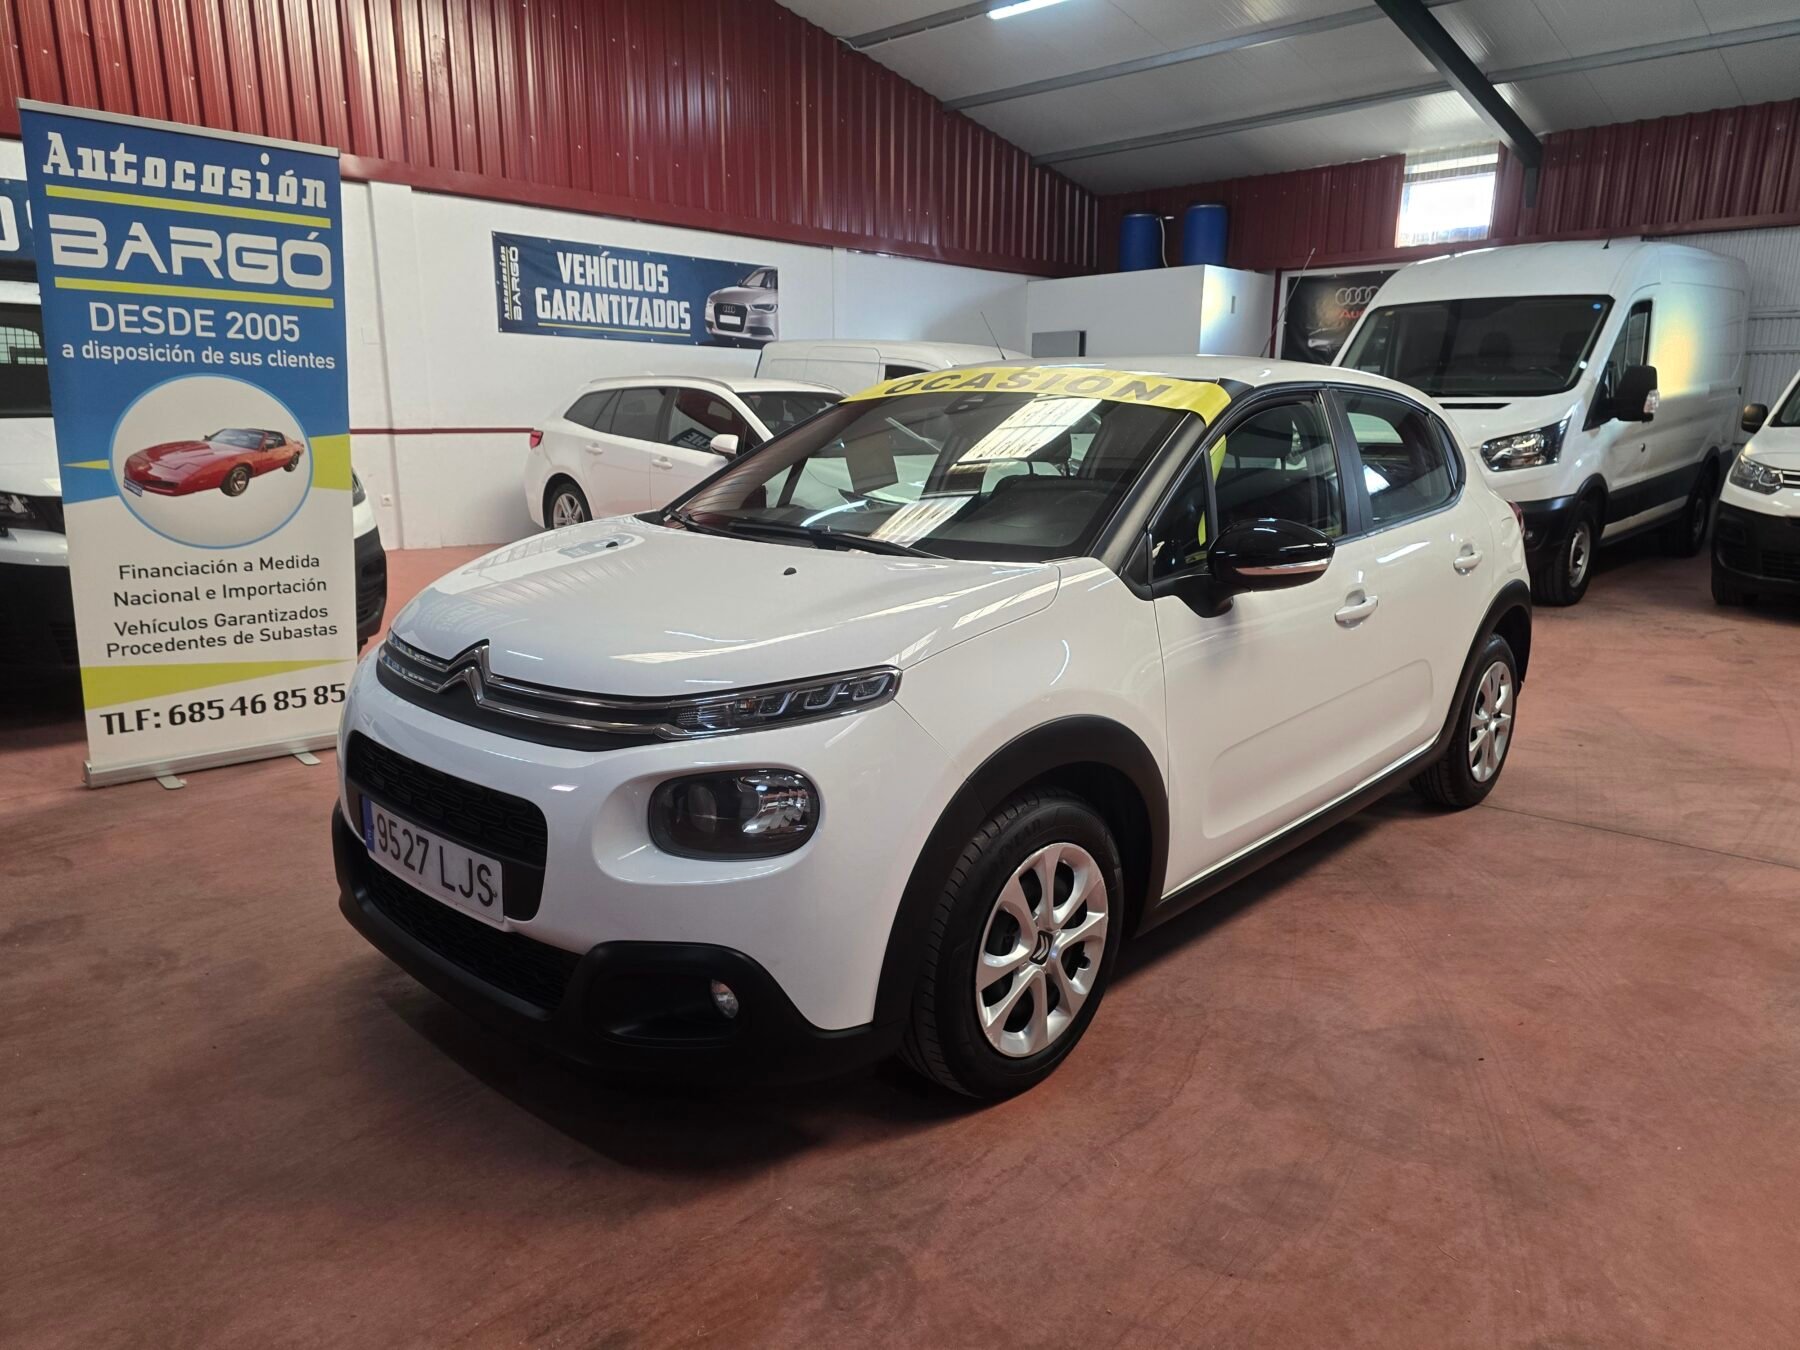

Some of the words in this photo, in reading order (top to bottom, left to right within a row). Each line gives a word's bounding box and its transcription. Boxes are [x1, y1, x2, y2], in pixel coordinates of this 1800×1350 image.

[43, 131, 327, 208] Autocasión
[49, 213, 332, 291] BARGÓ
[556, 251, 669, 294] VEHÍCULOS
[89, 302, 216, 338] DESDE
[226, 311, 300, 342] 2005
[534, 287, 691, 331] GARANTIZADOS
[1339, 307, 1365, 320] Au
[62, 342, 74, 358] a
[81, 340, 195, 364] disposición
[201, 346, 225, 365] de
[230, 349, 262, 366] sus
[267, 349, 336, 370] clientes
[884, 371, 1173, 402] OCASION
[119, 559, 238, 580] Financiación
[243, 560, 253, 572] a
[259, 554, 320, 571] Medida
[113, 586, 200, 607] Nacional
[206, 587, 217, 600] e
[222, 578, 327, 600] Importación
[106, 628, 227, 658] Procedentes
[233, 630, 254, 645] de
[260, 622, 338, 642] Subastas
[114, 615, 208, 637] Vehículos
[214, 605, 329, 628] Garantizados
[100, 708, 162, 736] TLF:
[168, 698, 225, 727] 685
[229, 693, 267, 717] 46
[273, 687, 307, 712] 85
[313, 683, 346, 706] 85
[377, 813, 430, 875] 9527
[439, 845, 495, 908] LJS
